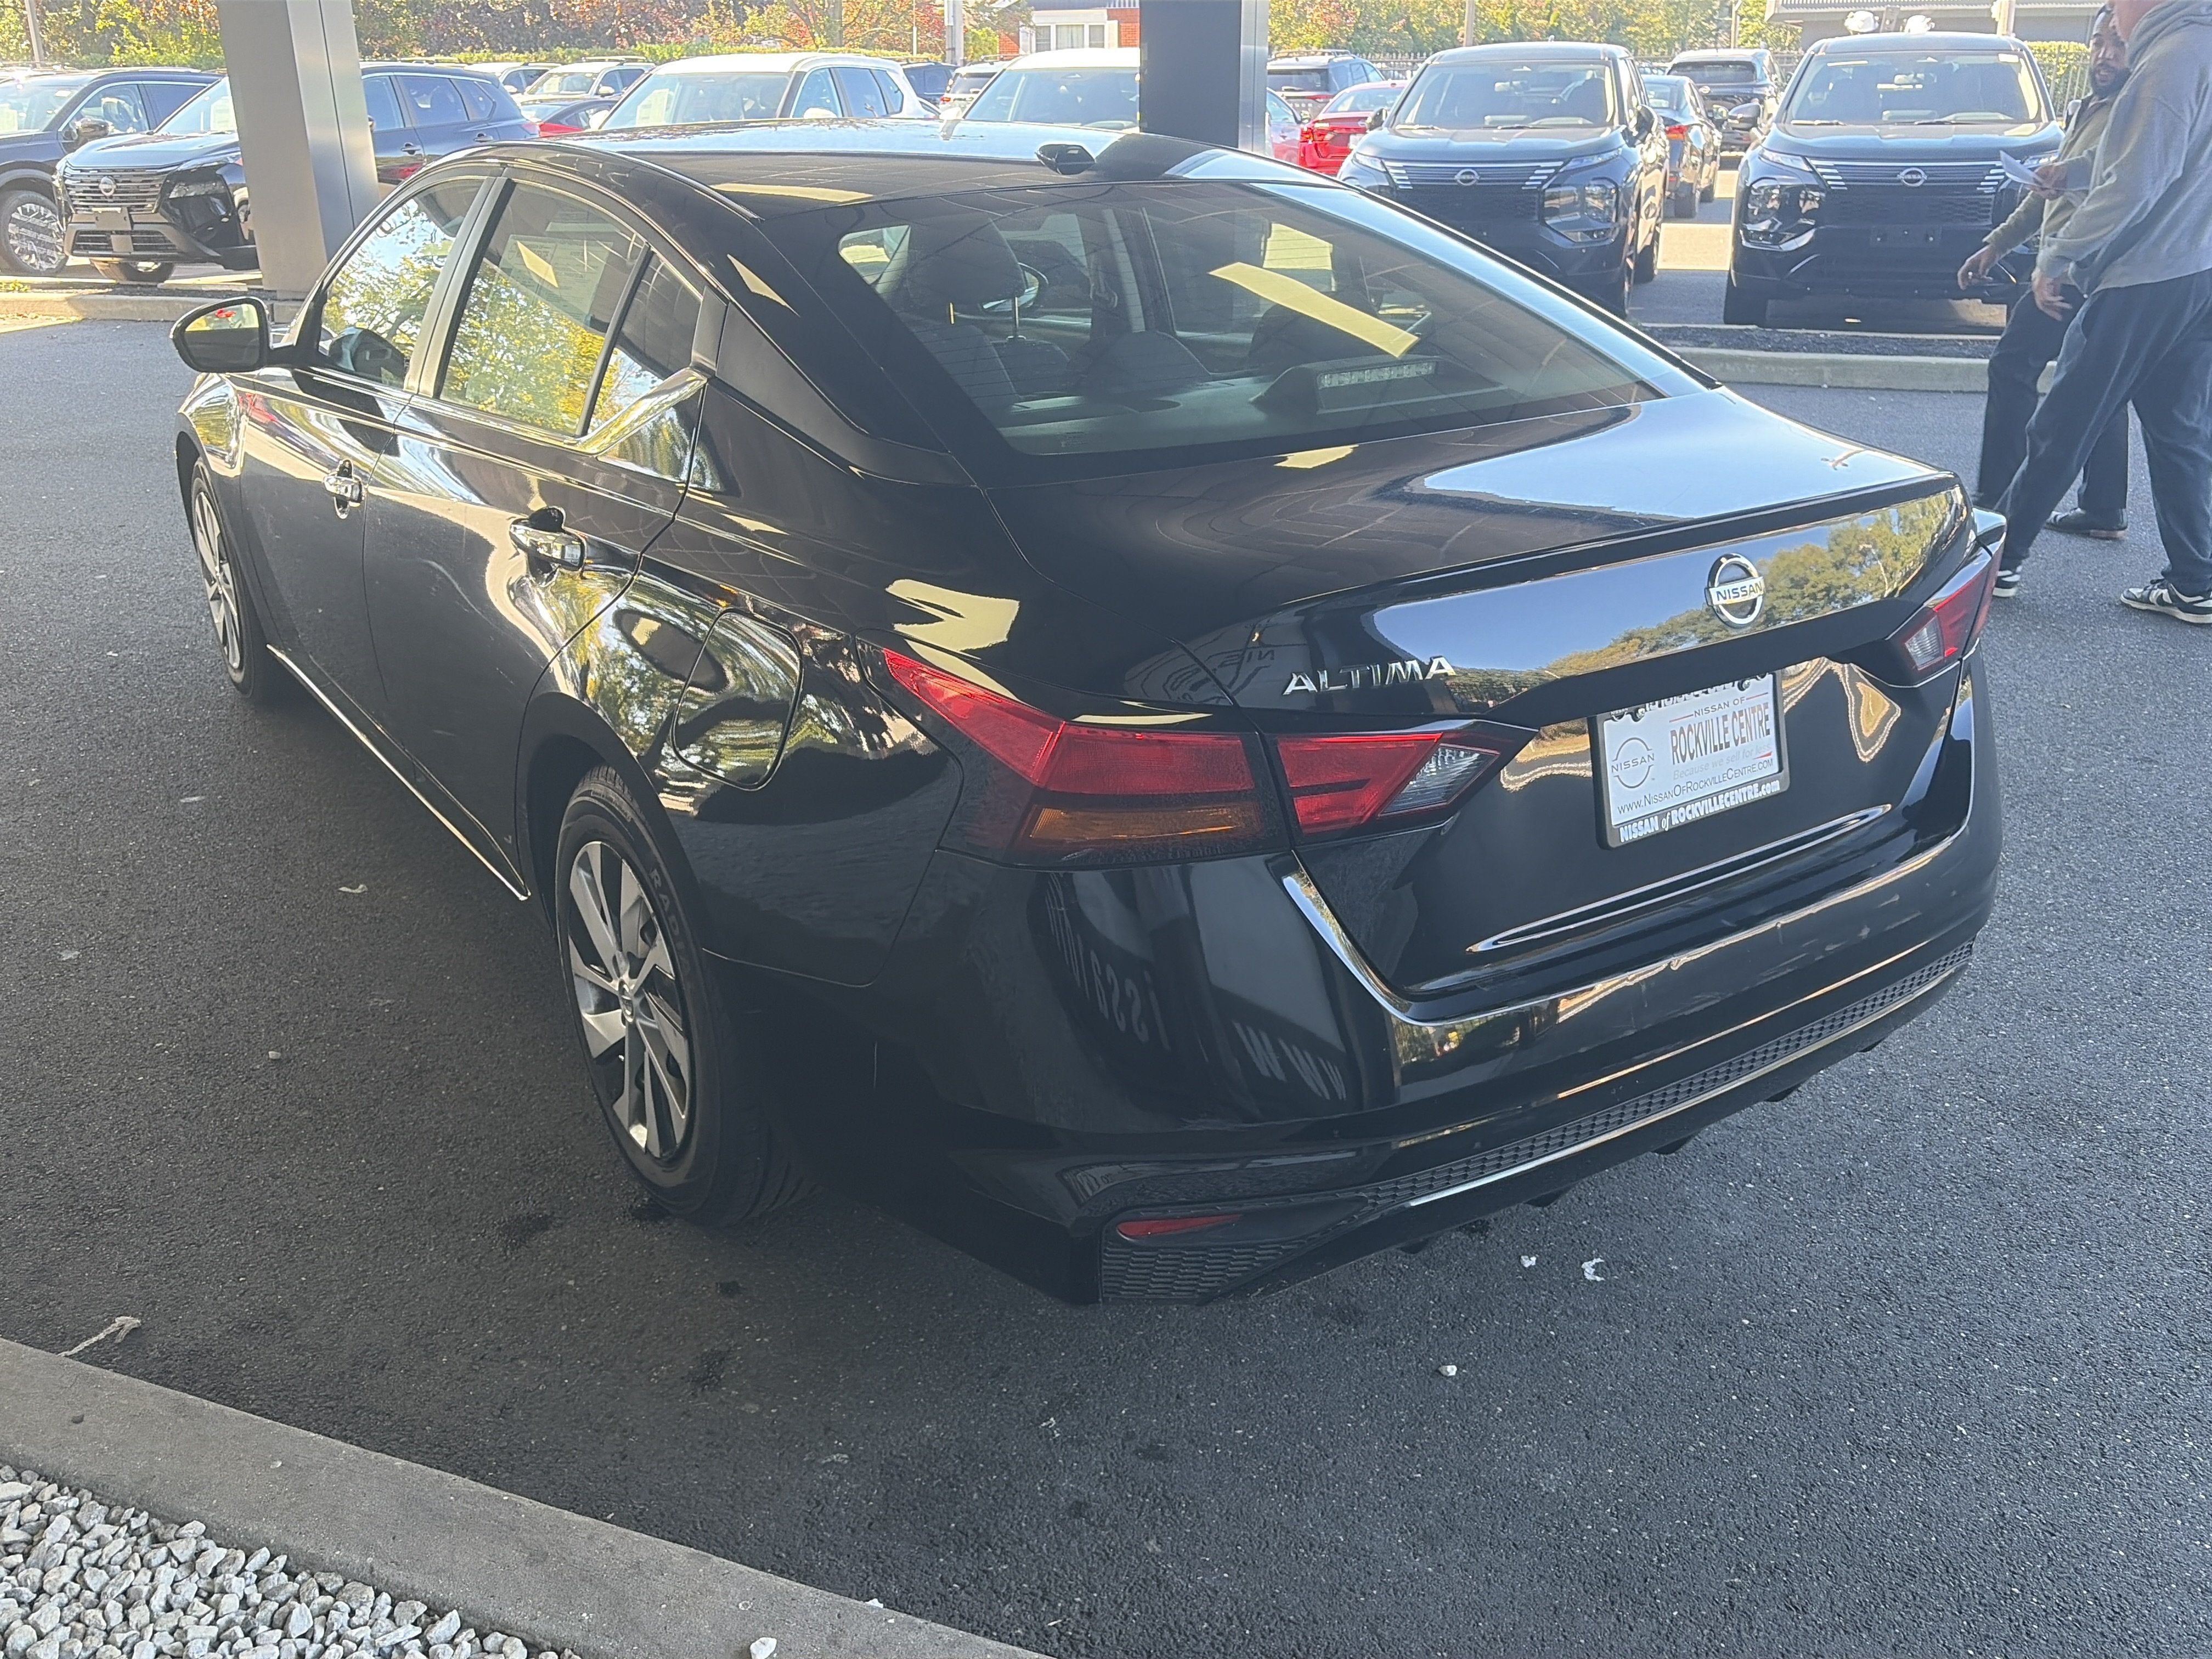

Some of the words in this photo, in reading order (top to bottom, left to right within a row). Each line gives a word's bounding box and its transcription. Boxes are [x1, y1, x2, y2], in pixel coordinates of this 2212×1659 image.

[1716, 581, 1762, 601] NISSAN
[1283, 655, 1457, 695] ALTIMA
[1694, 702, 1729, 718] NISSAN
[1733, 697, 1746, 706] OF
[1670, 714, 1730, 765] ROCKVILLE
[1731, 702, 1770, 747] CENTRE
[1611, 753, 1655, 773] NISSAN
[1673, 761, 1710, 780] Because
[1712, 759, 1724, 768] we
[1726, 751, 1740, 763] sell
[1741, 748, 1754, 759] for
[1620, 816, 1659, 842] NISSAN
[1662, 812, 1671, 831] of
[1672, 780, 1780, 825] ROCKVILLECENTRE.com
[649, 868, 692, 994] RADIA
